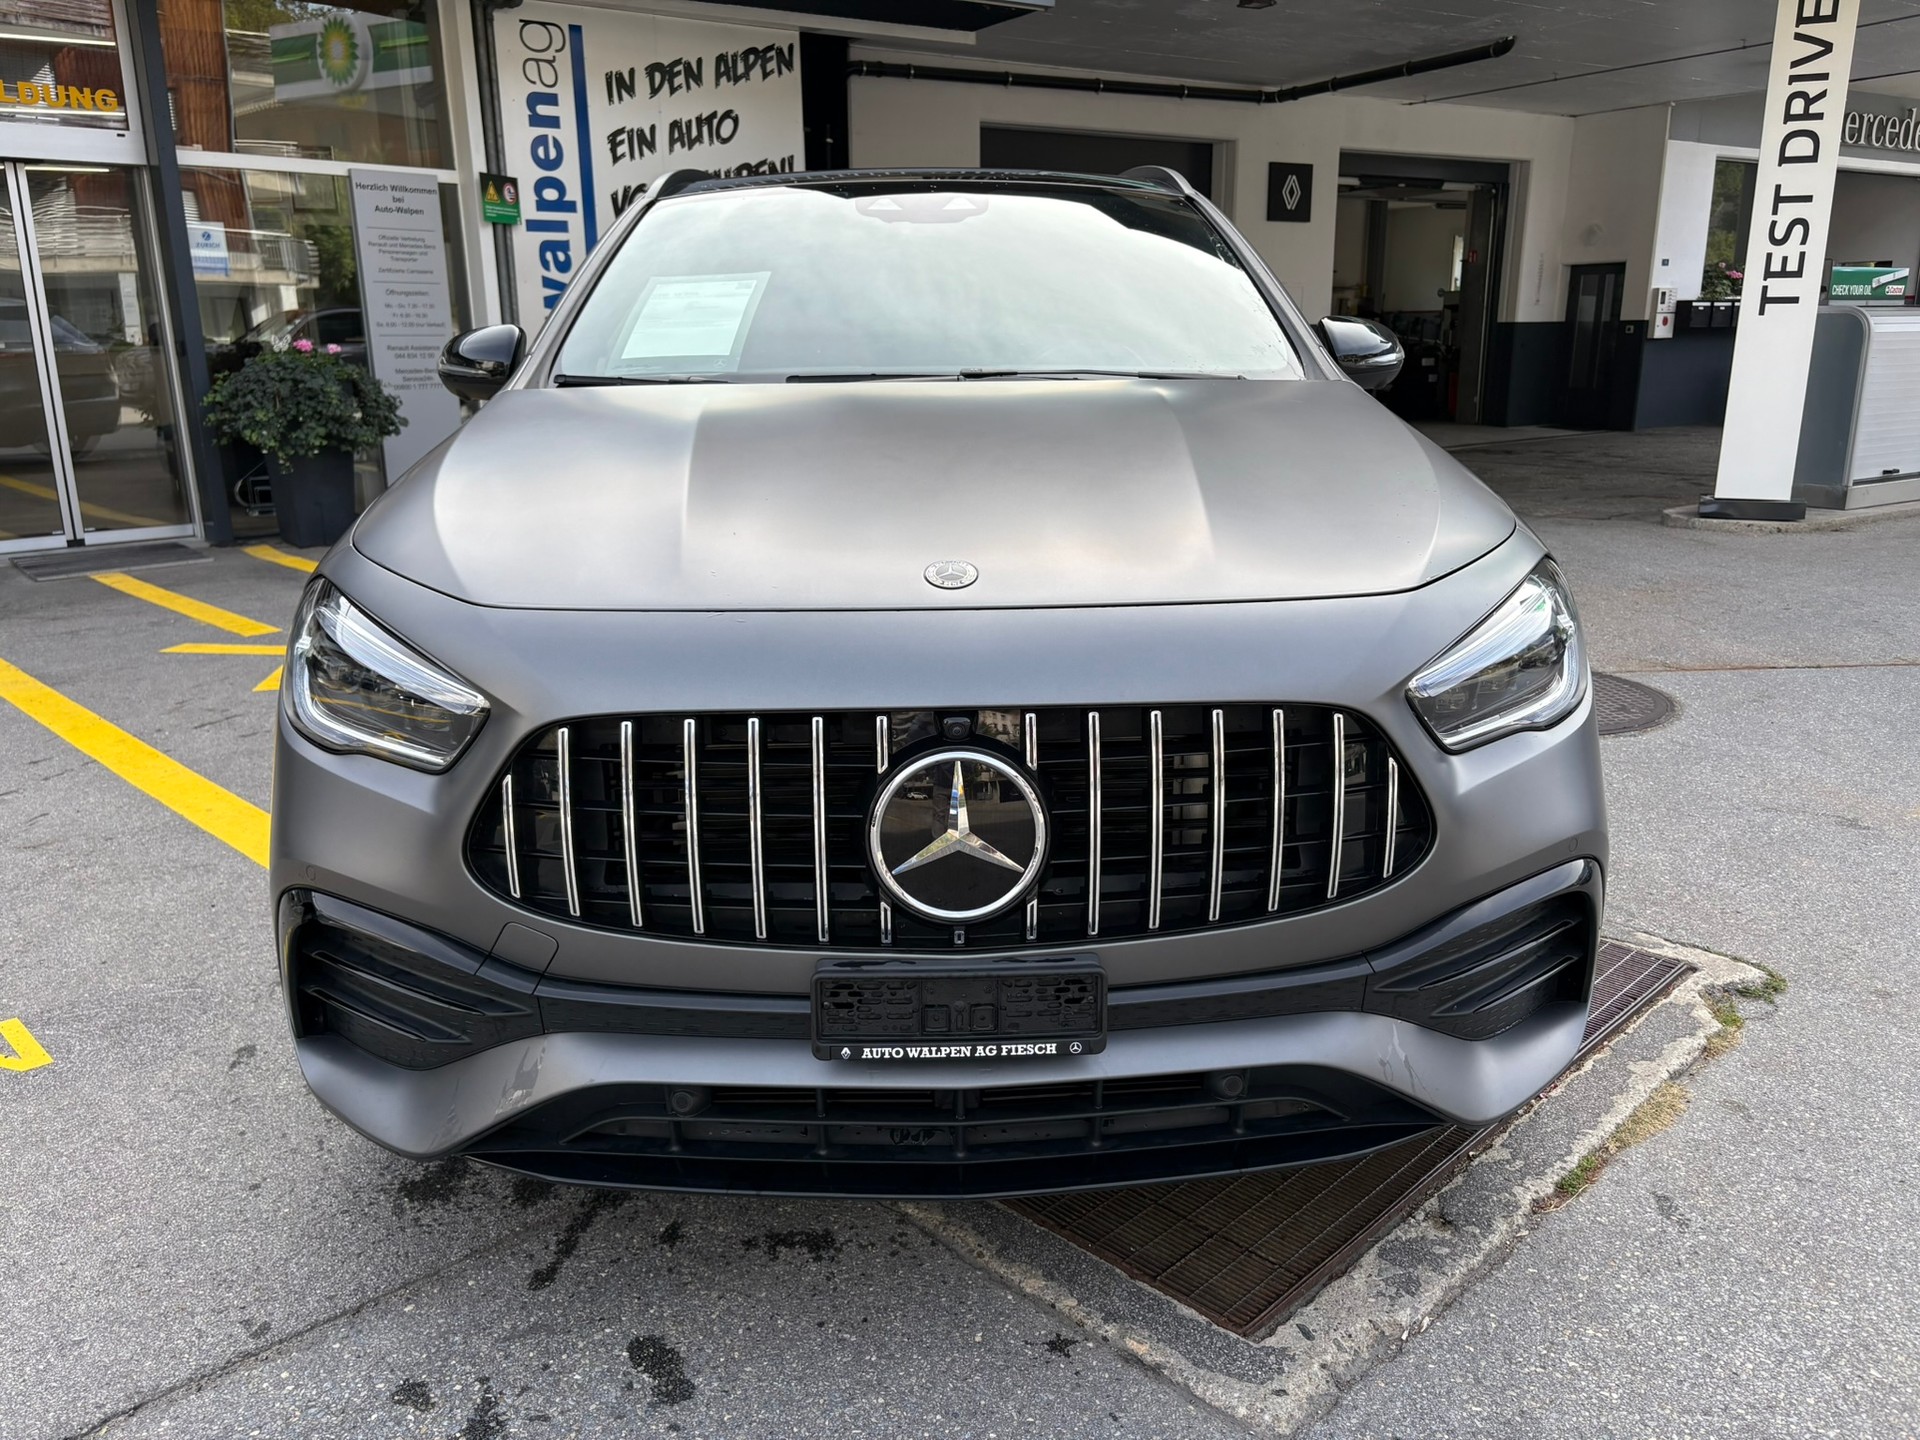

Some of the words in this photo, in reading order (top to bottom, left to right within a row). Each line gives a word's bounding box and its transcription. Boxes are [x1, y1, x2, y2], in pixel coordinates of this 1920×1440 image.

[605, 67, 636, 106] IN
[645, 57, 704, 100] DEN
[714, 43, 794, 89] ALPEN
[1777, 0, 1840, 168] DRIVE
[607, 124, 657, 166] EIN
[668, 109, 739, 155] AUTO
[355, 181, 388, 192] Herzlich
[390, 184, 438, 195] Willkommen
[374, 204, 425, 216] Auto-Walpen
[1758, 184, 1814, 316] TEST
[1831, 284, 1850, 296] CHECK
[1849, 284, 1864, 296] YOUR
[1863, 284, 1873, 296] OIL
[861, 1048, 904, 1060] AUTO
[906, 1046, 972, 1058] WALPEN
[975, 1045, 998, 1057] AG
[1000, 1043, 1057, 1056] FIESCH
